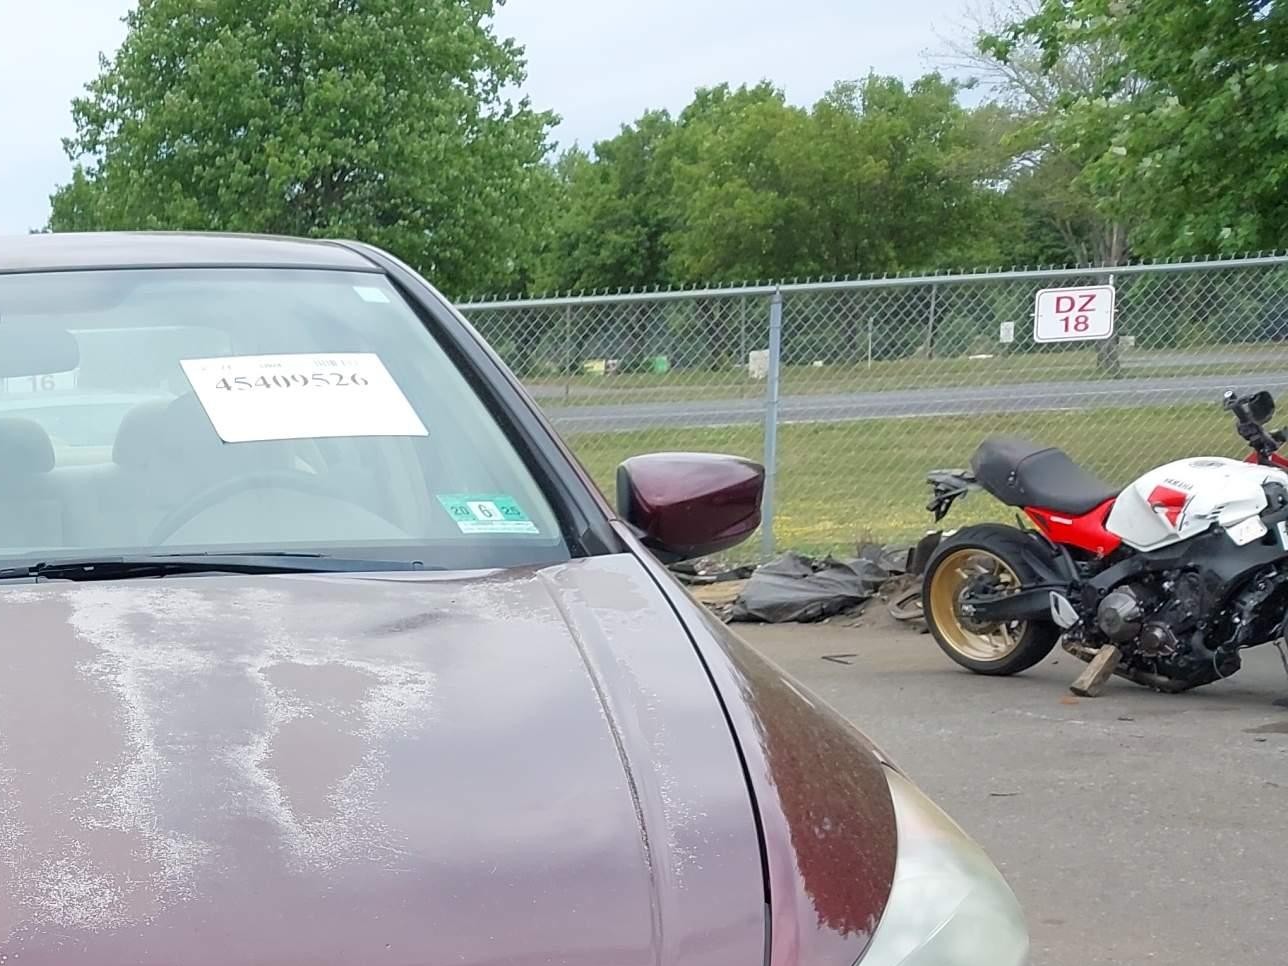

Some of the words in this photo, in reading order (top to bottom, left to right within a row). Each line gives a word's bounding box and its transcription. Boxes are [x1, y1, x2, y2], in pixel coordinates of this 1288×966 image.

[1055, 294, 1097, 314] DZ
[1059, 315, 1089, 333] 18
[215, 372, 369, 391] 45409526
[450, 506, 470, 516] 20
[478, 503, 493, 518] 6
